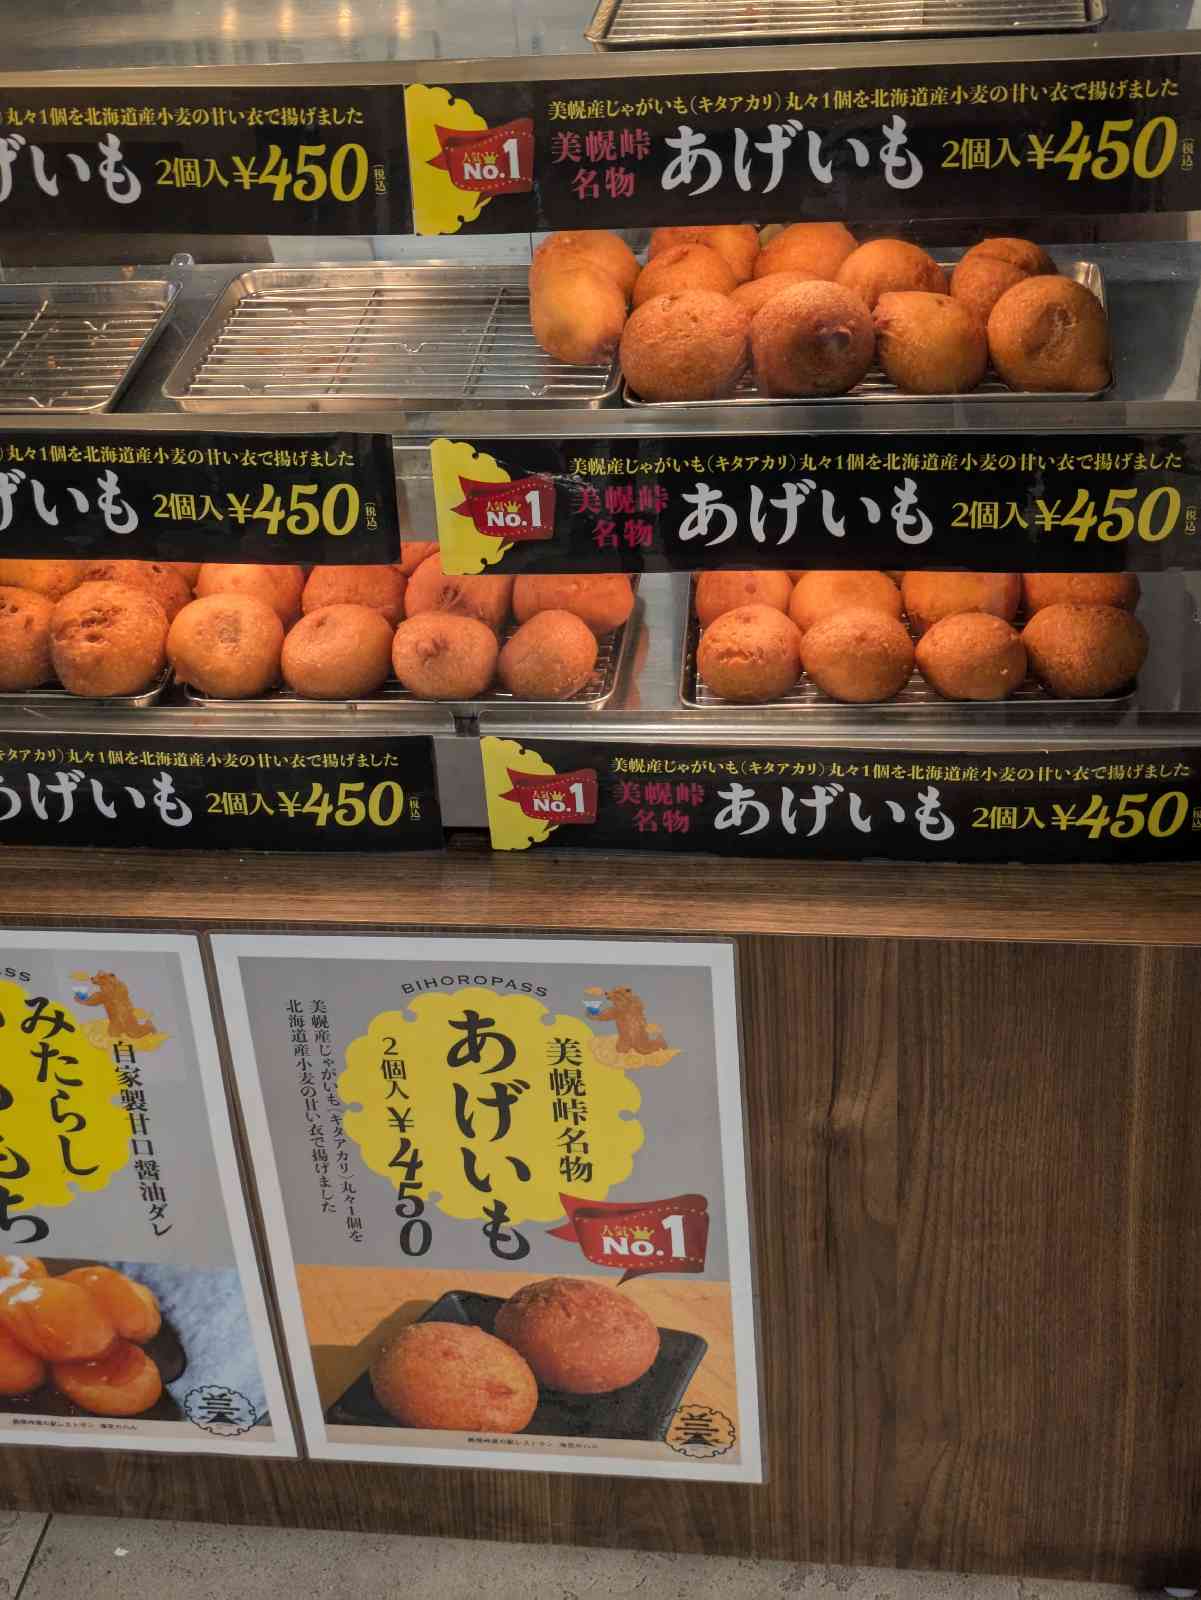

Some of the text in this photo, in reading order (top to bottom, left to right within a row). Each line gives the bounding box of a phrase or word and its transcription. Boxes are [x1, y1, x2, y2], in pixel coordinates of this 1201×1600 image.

[551, 128, 651, 163] 美幌峠
[660, 115, 923, 197] あげいも
[942, 139, 1020, 169] 2個入
[1028, 117, 1177, 179] ¥450
[158, 158, 228, 187] 2個入
[233, 144, 368, 201] ¥450
[572, 167, 635, 200] 名物
[153, 493, 223, 520] 2個入
[227, 484, 359, 535] ¥450
[571, 484, 669, 515] 美幌峠
[679, 478, 932, 545] あげいも
[952, 502, 1028, 528] 2個入
[1035, 487, 1180, 541] ¥450
[597, 520, 652, 546] 名物
[207, 792, 274, 815] 2個入
[278, 782, 403, 825] ¥450
[613, 781, 705, 807] 美幌峠
[715, 783, 954, 840] あげいも
[973, 807, 1044, 829] 2個入
[1052, 792, 1187, 838] ¥450
[636, 809, 688, 832] 名物
[401, 974, 549, 998] BIHOROPASS
[21, 997, 99, 1175] みたらし
[546, 1037, 593, 1183] 美幌峠名物
[446, 1009, 531, 1261] あげいも
[387, 1106, 433, 1257] ¥450
[602, 1215, 687, 1258] No.1
